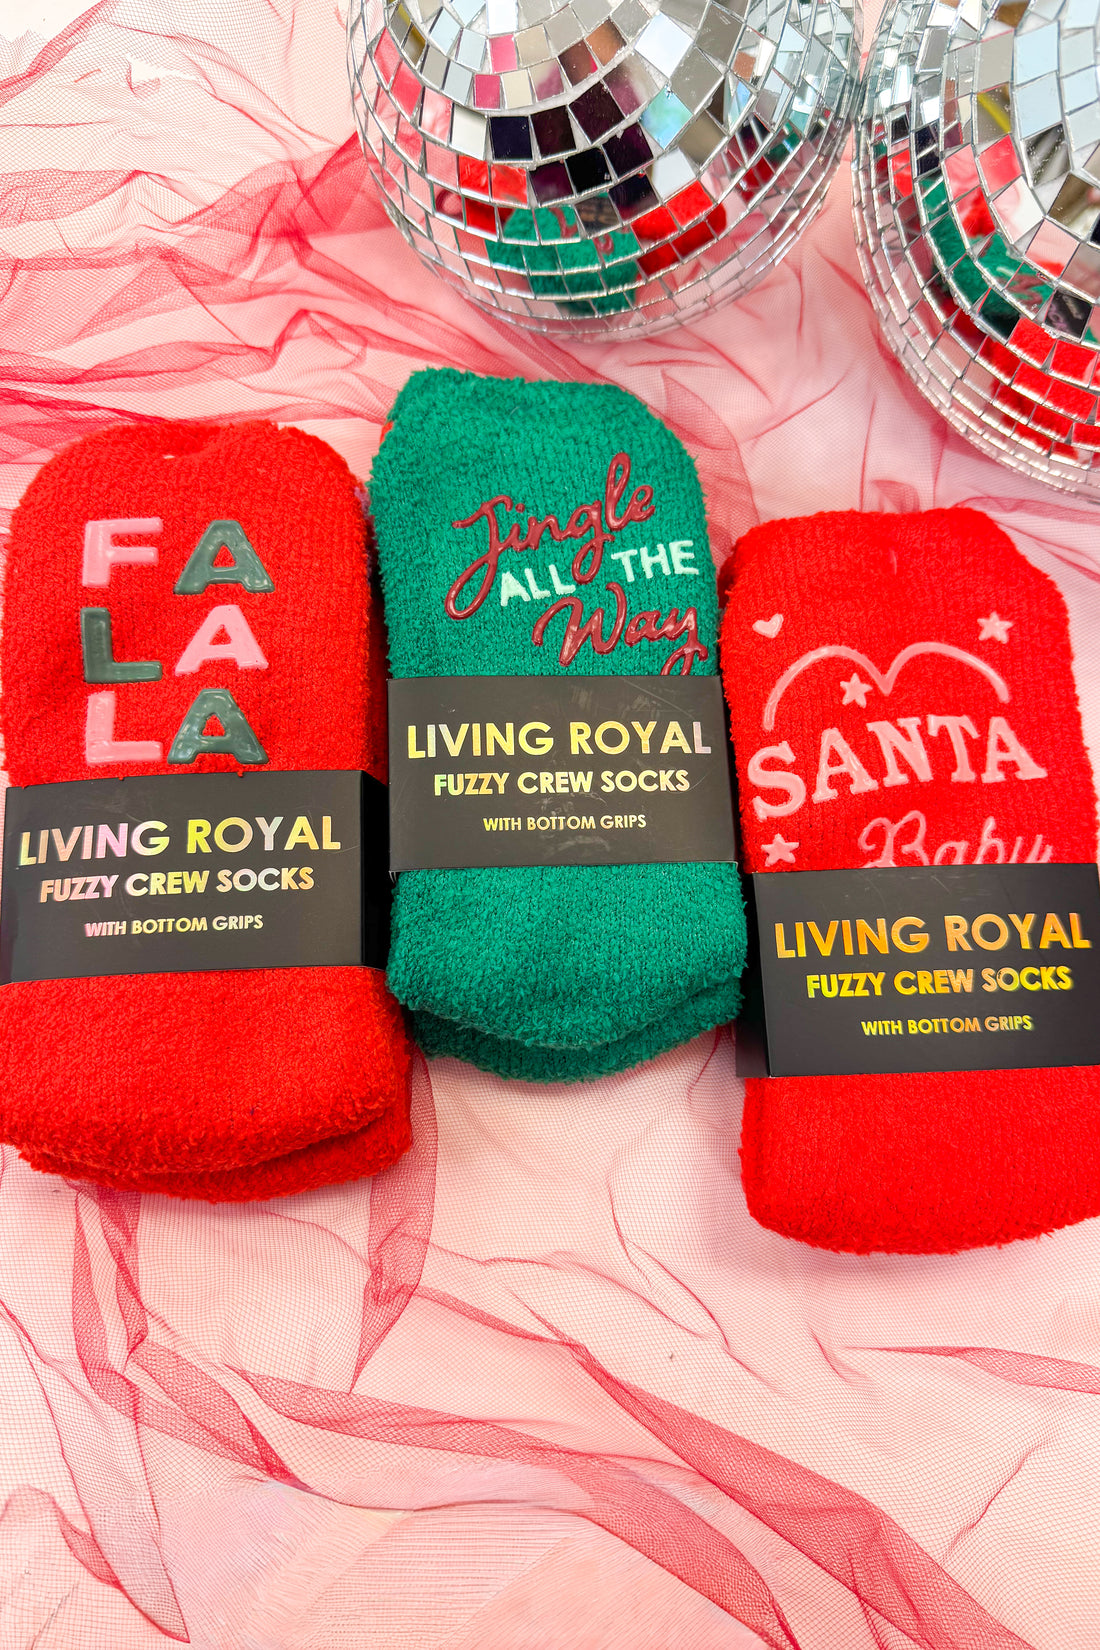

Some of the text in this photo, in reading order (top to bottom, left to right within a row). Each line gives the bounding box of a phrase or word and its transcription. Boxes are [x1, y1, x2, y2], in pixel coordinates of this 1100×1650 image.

[444, 452, 656, 620] Jingle
[499, 539, 700, 607] ALL THE
[531, 581, 709, 677] Way
[407, 720, 712, 760] LIVING ROYAL
[433, 769, 691, 796] FUZZY CREW SOCKS
[746, 715, 1049, 821] SANTA
[18, 815, 342, 867] LIVING ROYAL
[483, 814, 647, 832] WITH BOTTOM GRIPS
[38, 866, 316, 904] FUZZY CREW SOCKS
[85, 914, 264, 938] WITH BOTTOM GRIPS
[774, 912, 1092, 960] LIVING ROYAL
[807, 966, 1074, 998] FUZZY CREW SOCKS
[861, 1015, 1035, 1037] WITH BOTTOM GRIPS
